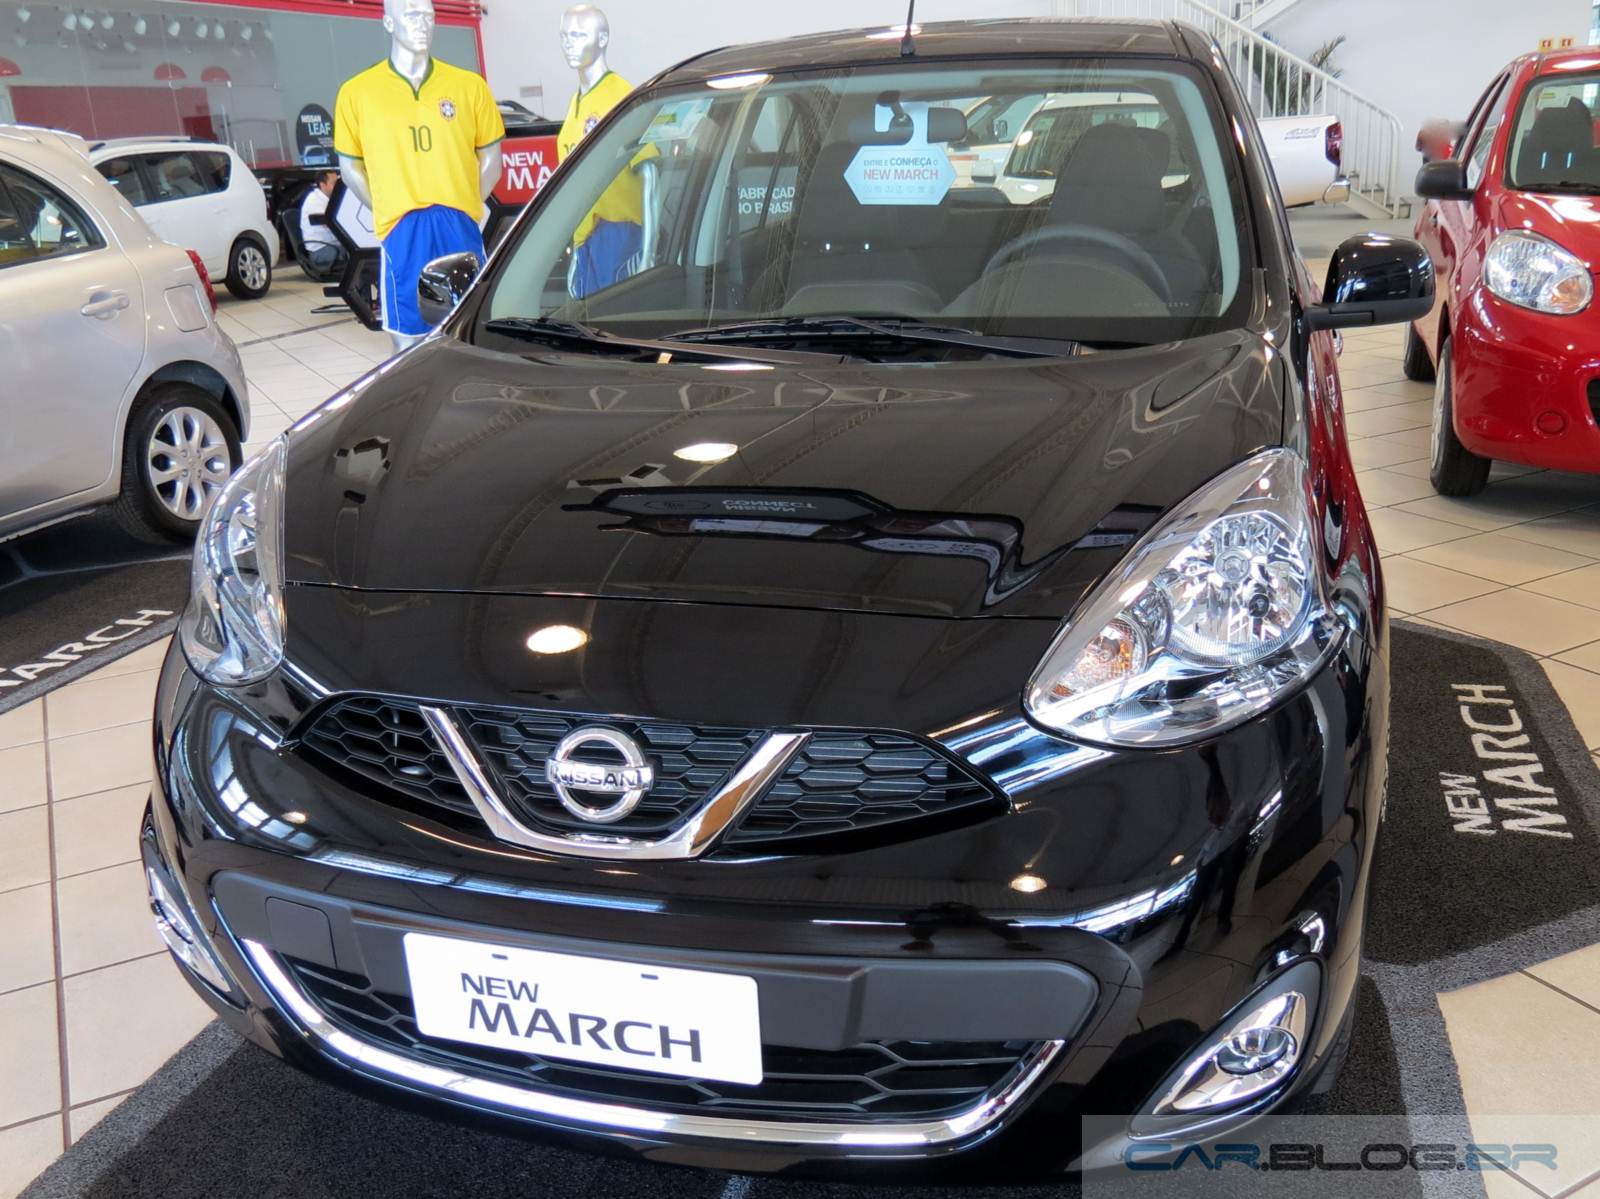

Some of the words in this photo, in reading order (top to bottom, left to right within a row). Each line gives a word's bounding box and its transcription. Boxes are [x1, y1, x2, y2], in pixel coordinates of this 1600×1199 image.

[300, 114, 322, 123] NISSAN
[308, 121, 332, 136] LEAF
[408, 124, 433, 153] 10
[502, 151, 544, 168] NEW
[863, 168, 891, 180] NEW
[893, 168, 939, 180] MARCH
[737, 186, 796, 200] ABRCAD
[1450, 683, 1575, 840] MARCH
[552, 767, 637, 788] NISSAN
[1438, 771, 1499, 836] NEW
[460, 972, 539, 1003] NEW
[468, 998, 703, 1064] MARCH
